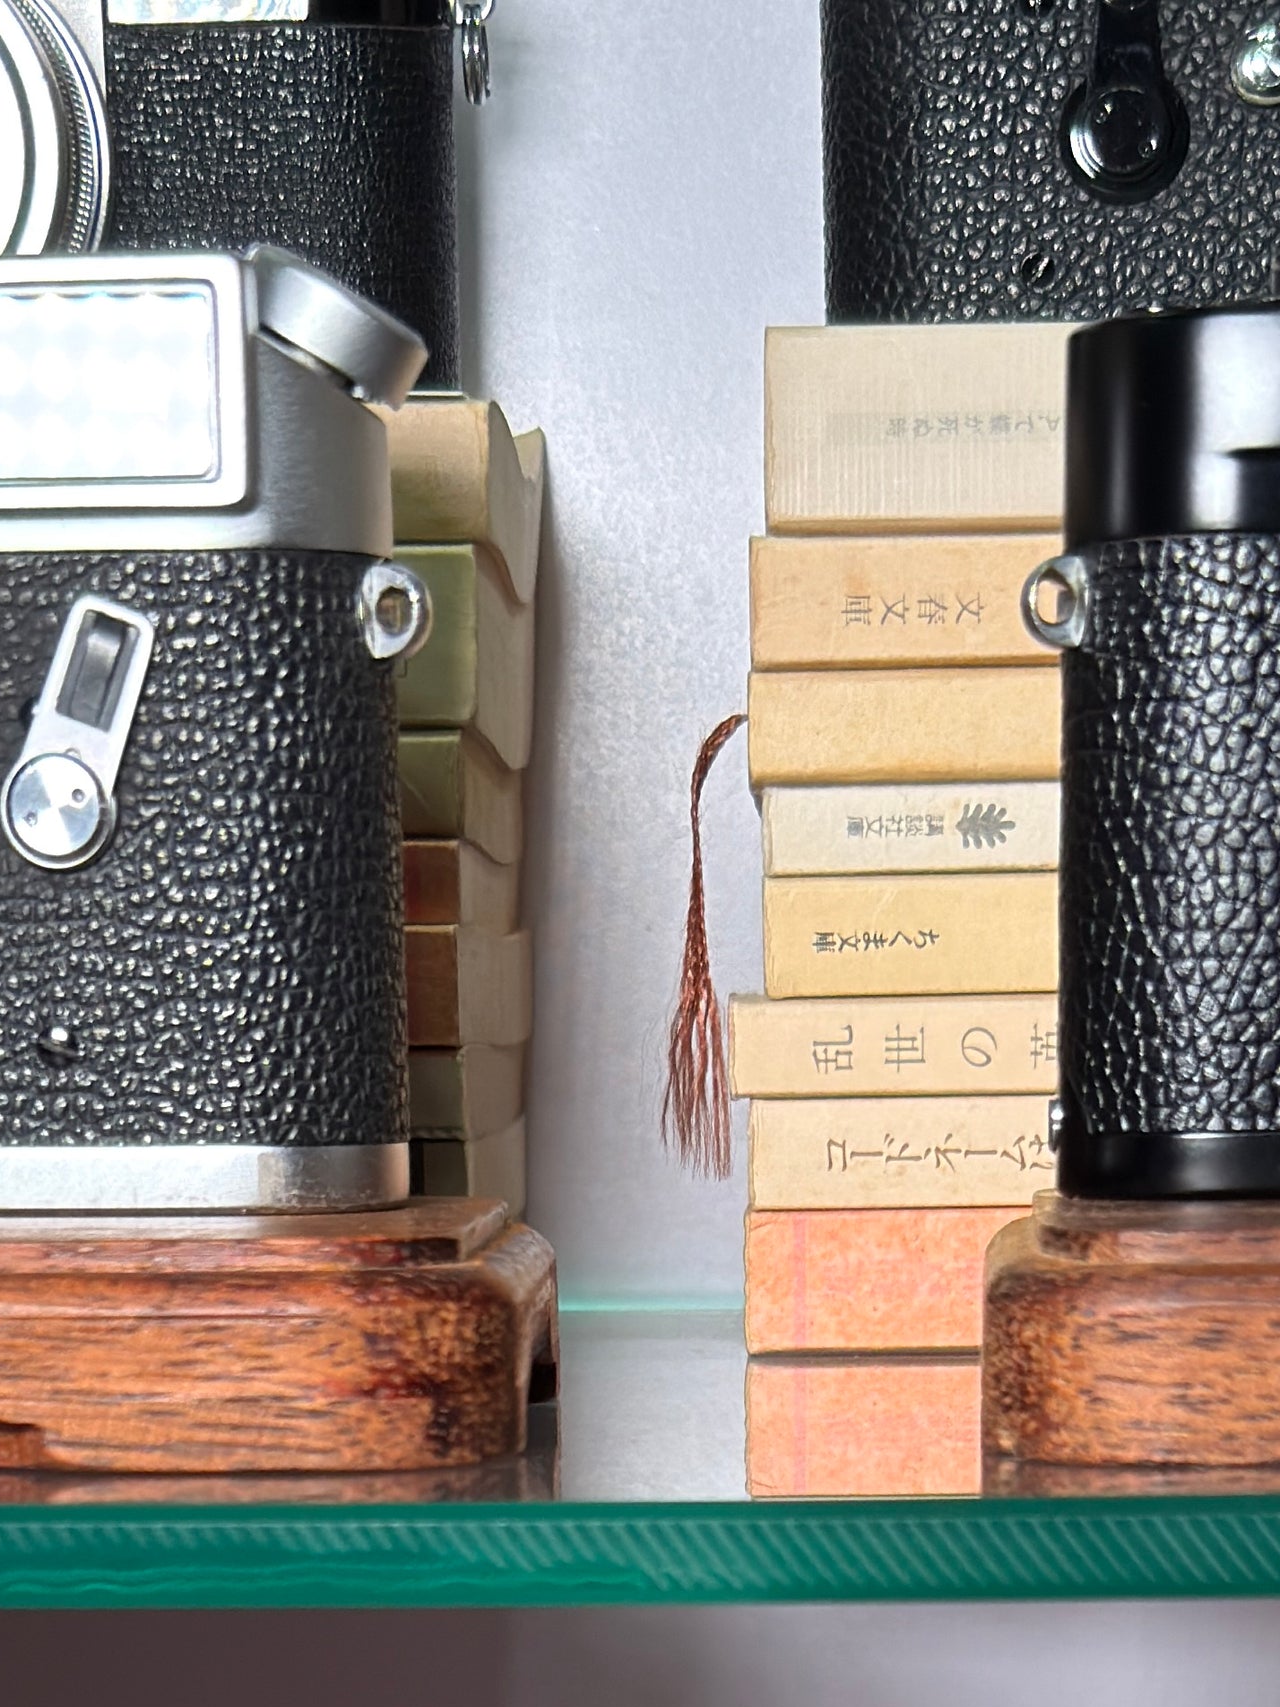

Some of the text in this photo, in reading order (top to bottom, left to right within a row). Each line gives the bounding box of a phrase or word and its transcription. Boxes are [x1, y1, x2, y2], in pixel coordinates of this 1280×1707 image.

[841, 591, 983, 628] 文春文庫
[846, 815, 945, 839] 講談社文庫
[813, 928, 940, 953] ちくま文庫
